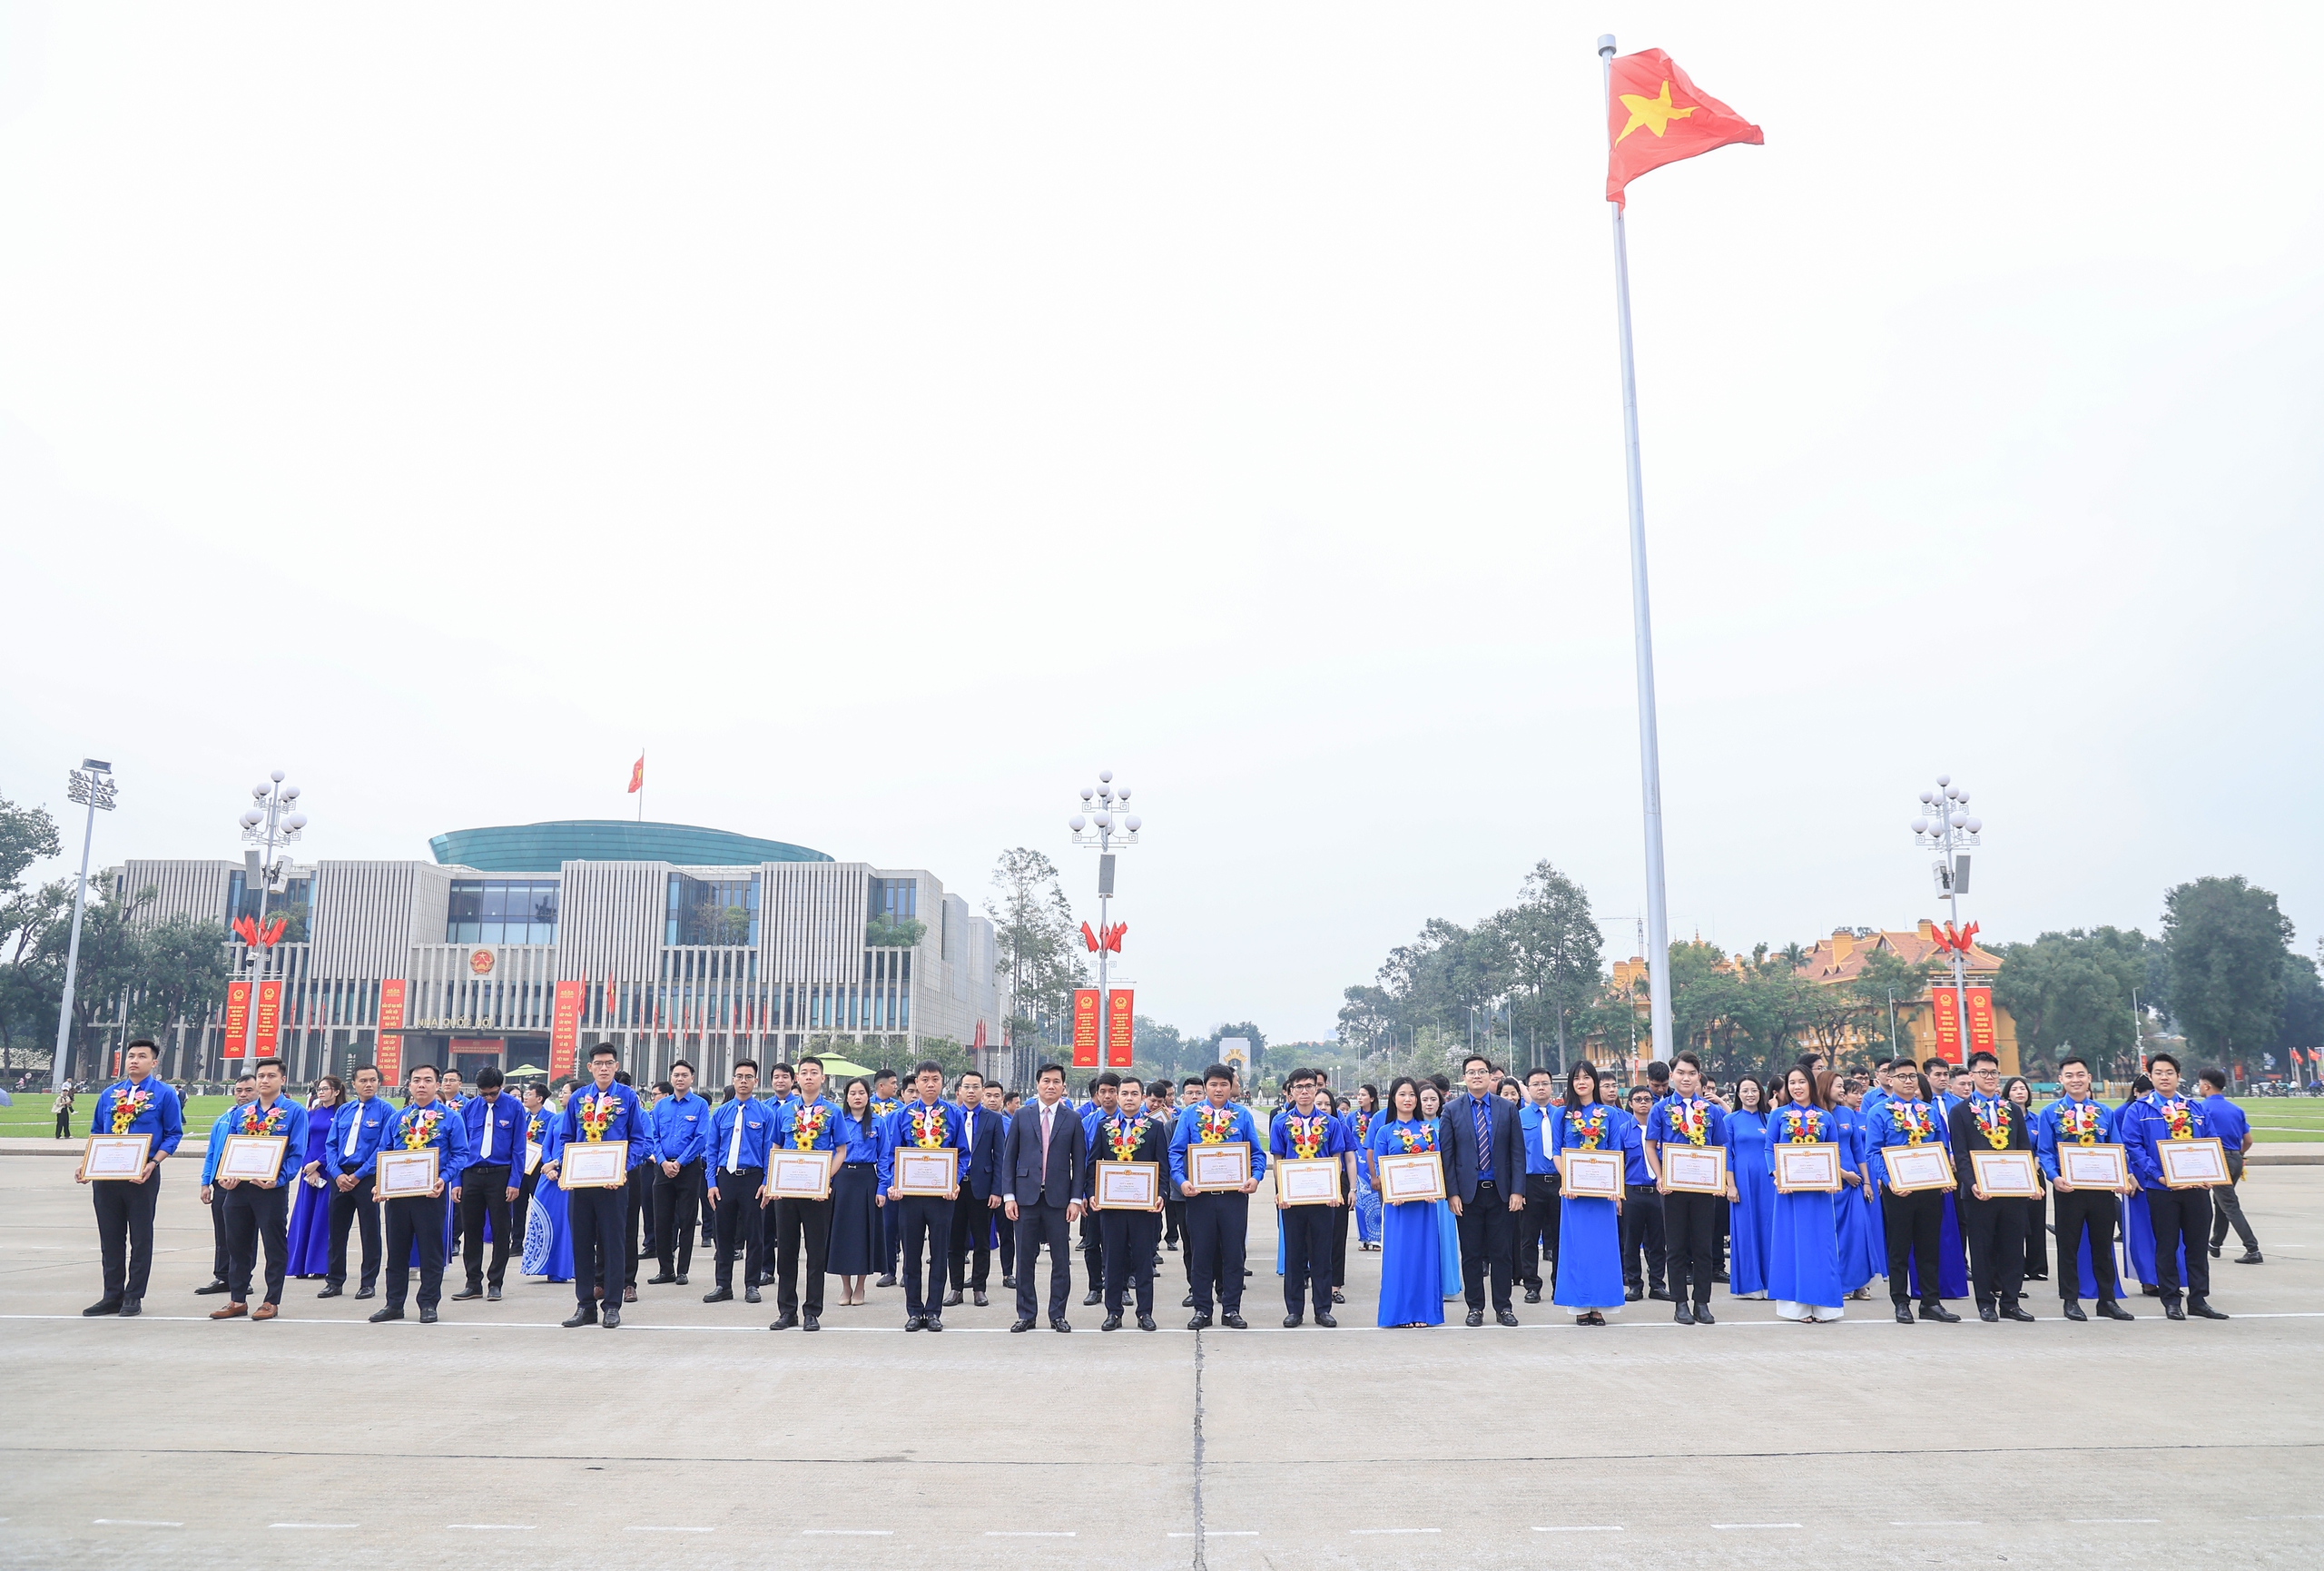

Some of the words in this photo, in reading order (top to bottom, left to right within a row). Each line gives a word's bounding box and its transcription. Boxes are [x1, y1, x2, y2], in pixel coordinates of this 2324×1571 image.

[418, 1016, 438, 1026] NHÀ
[442, 1014, 470, 1027] QUỐC
[476, 1016, 493, 1029] HỘI
